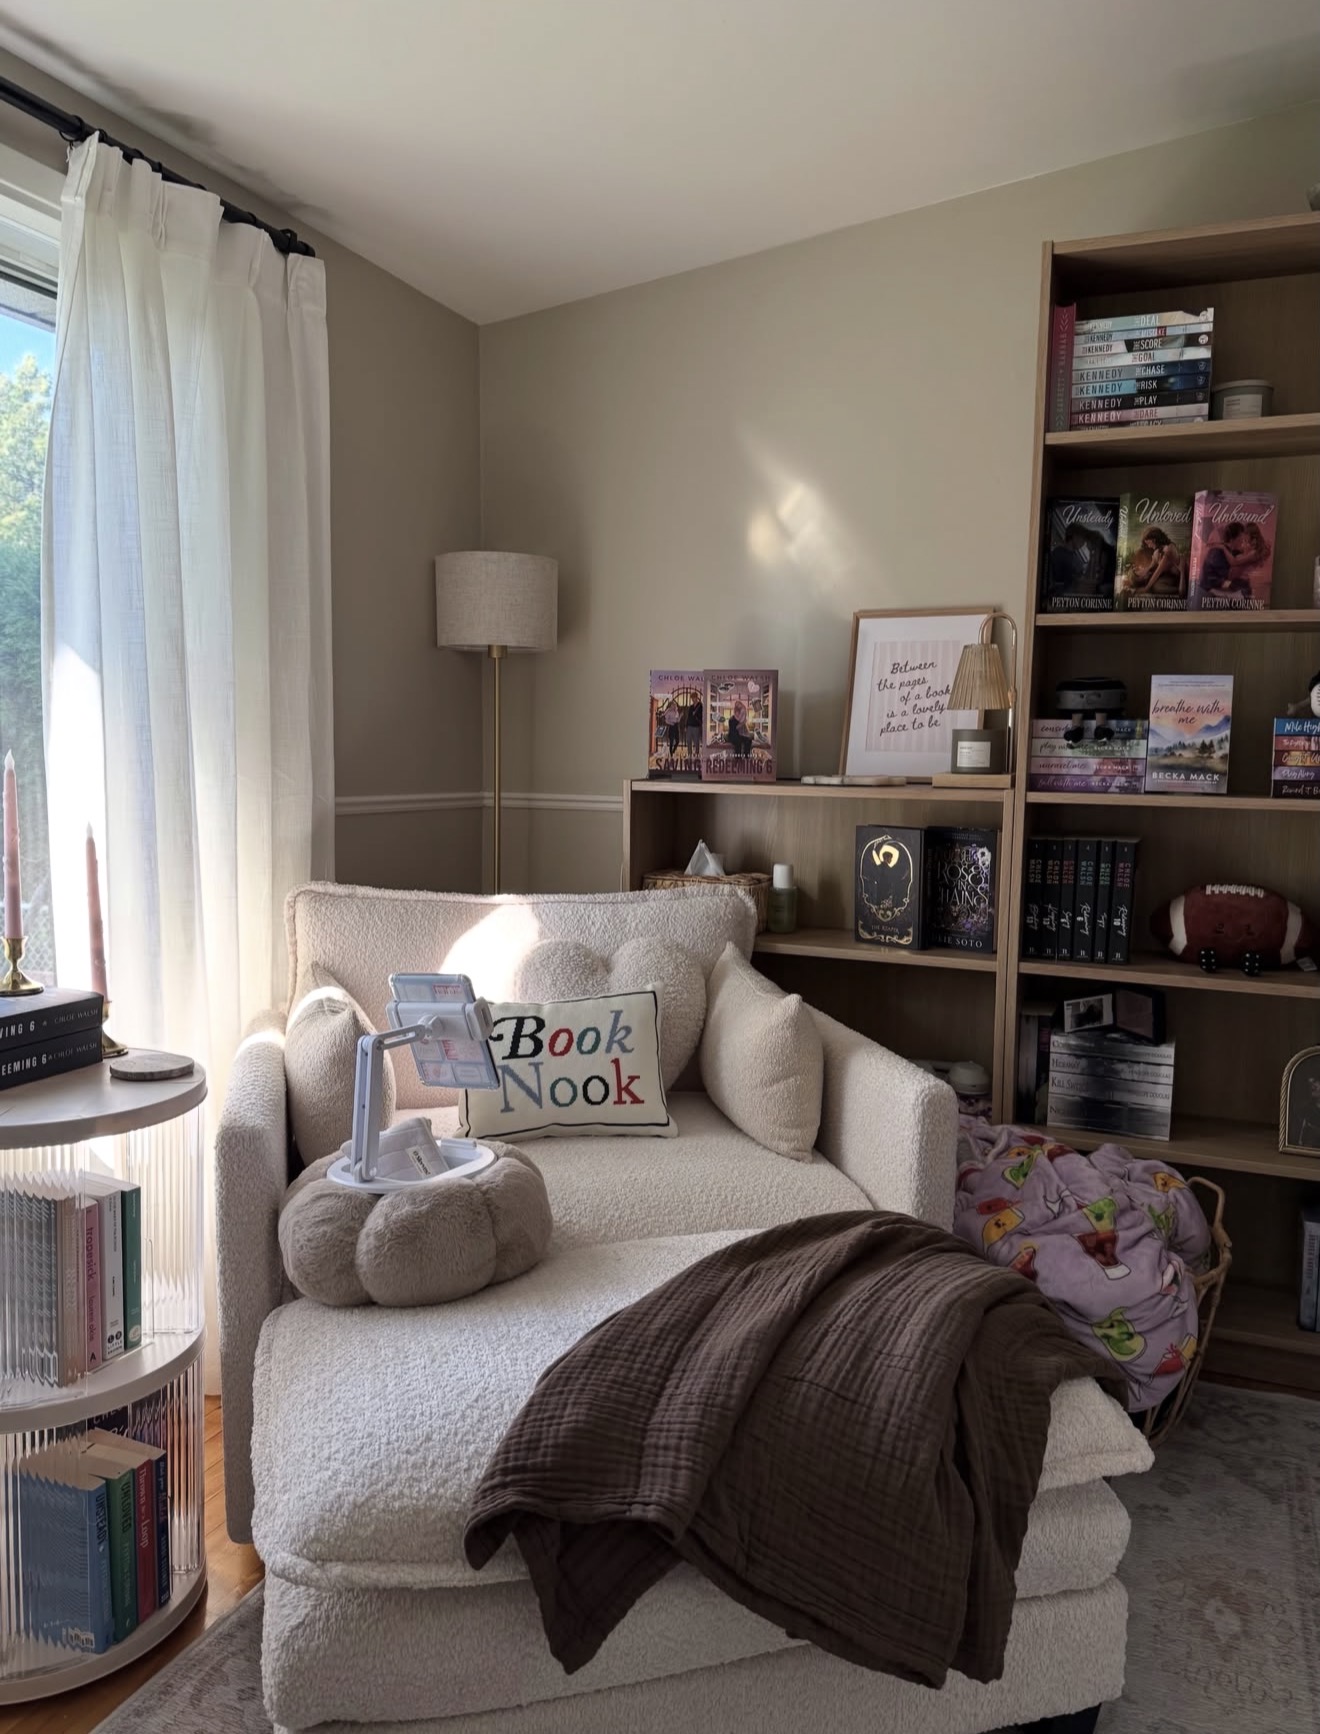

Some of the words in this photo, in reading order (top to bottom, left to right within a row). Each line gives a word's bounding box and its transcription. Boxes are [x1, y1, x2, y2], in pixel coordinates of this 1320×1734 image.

[1141, 315, 1160, 326] DEAL
[1088, 344, 1112, 353] KENNEDY
[1141, 339, 1161, 350] SCORE
[1138, 352, 1154, 362] GOAL
[1080, 368, 1122, 381] KENNEDY
[1141, 364, 1165, 376] CHASE
[1080, 383, 1122, 395] KENNEDY
[1141, 380, 1157, 391] RISK
[1080, 398, 1121, 410] KENNEDY
[1140, 395, 1157, 405] PLAY
[1079, 412, 1121, 424] KENNEDY
[1140, 409, 1157, 418] DARE
[1062, 505, 1114, 529] Unsteady
[1136, 498, 1192, 524] Unloved
[1208, 502, 1274, 524] Unbound
[1052, 597, 1080, 609] PEYTON
[1080, 598, 1112, 609] CORINNE
[1127, 597, 1155, 609] PEYTON
[1201, 596, 1230, 608] PEYTON
[1230, 598, 1264, 610] CORINNE
[891, 660, 937, 675] Between
[877, 679, 896, 692] the
[899, 677, 929, 690] pages
[900, 693, 911, 705] of
[915, 693, 922, 701] a
[926, 685, 951, 699] book
[887, 710, 897, 718] is
[901, 709, 909, 718] a
[913, 701, 945, 715] lovely
[1152, 699, 1193, 714] breathe
[1197, 699, 1224, 714] with
[880, 721, 909, 737] place
[912, 718, 925, 730] to
[928, 715, 941, 728] be
[1178, 716, 1196, 724] me
[1284, 721, 1302, 732] Mile
[656, 758, 702, 772] SAVING
[706, 759, 762, 774] REDEEMING
[766, 759, 773, 774] 6
[1152, 772, 1185, 780] BECKA
[1190, 773, 1220, 781] MACK
[1086, 861, 1094, 886] CHLOE
[940, 888, 988, 906] HAINS
[956, 938, 983, 949] SOTO
[54, 1013, 74, 1024] CHLOE
[78, 1008, 98, 1019] WALSH
[30, 1020, 35, 1032] 6
[489, 1010, 635, 1060] Book
[53, 1050, 73, 1060] CHLOE
[76, 1042, 97, 1053] WALSH
[1, 1056, 37, 1076] EEMING
[41, 1053, 47, 1065] 6
[497, 1058, 645, 1113] Nook
[121, 1481, 132, 1533] UNLOVED
[140, 1519, 150, 1549] Loop
